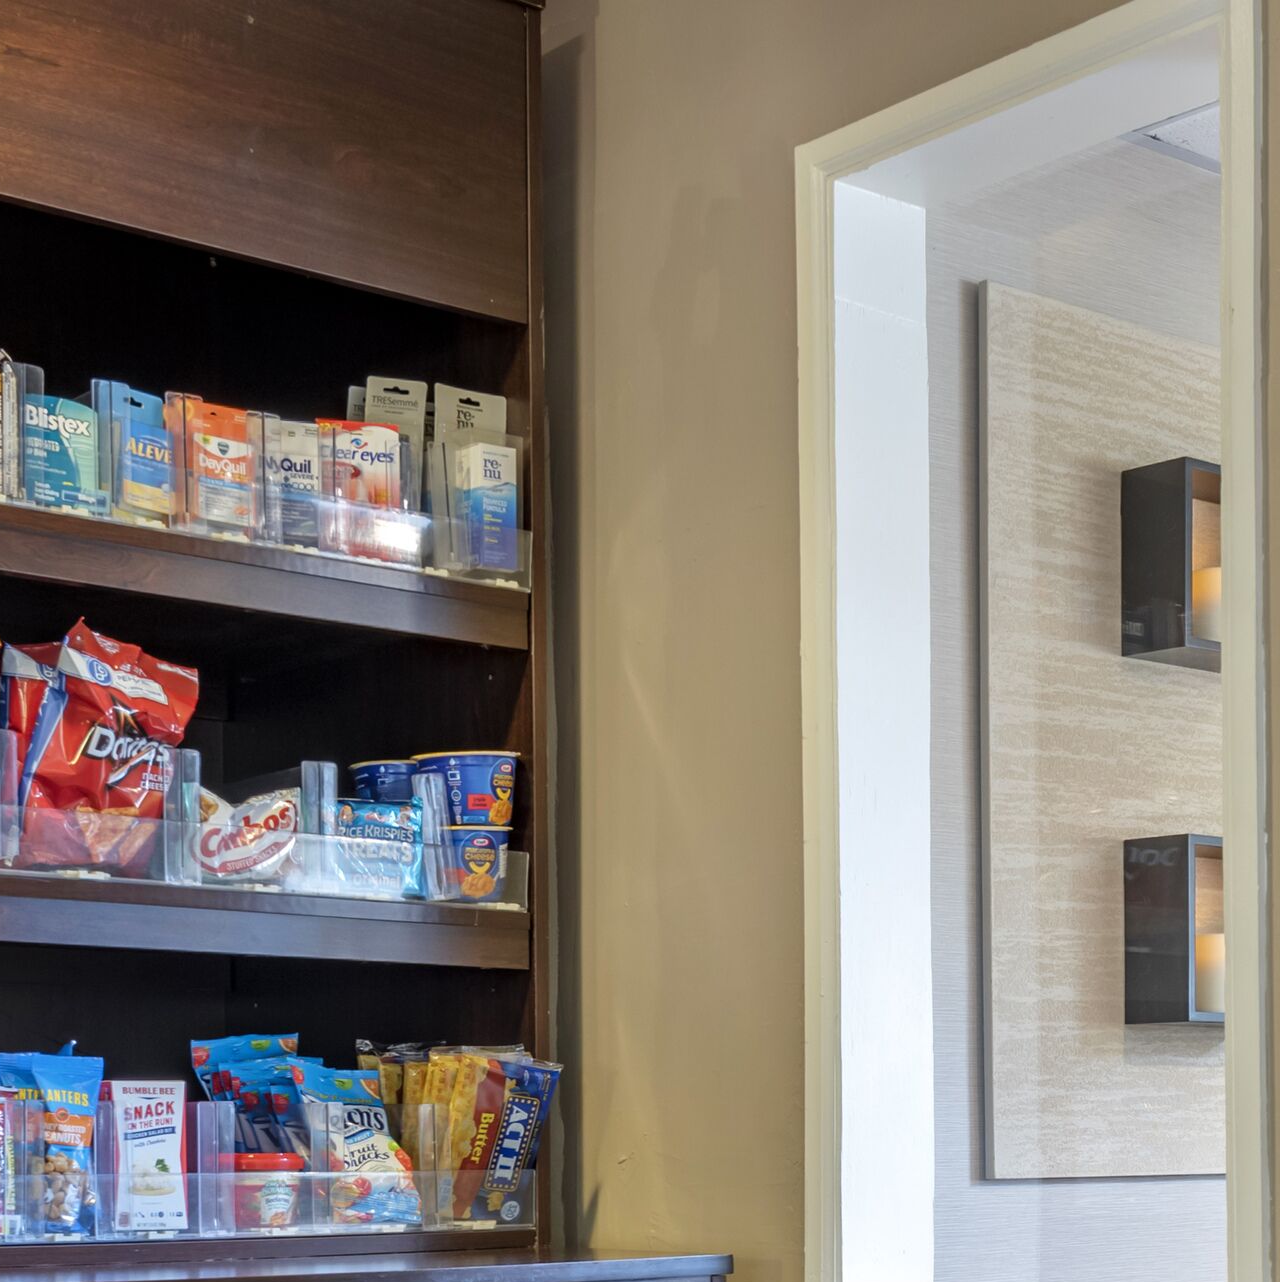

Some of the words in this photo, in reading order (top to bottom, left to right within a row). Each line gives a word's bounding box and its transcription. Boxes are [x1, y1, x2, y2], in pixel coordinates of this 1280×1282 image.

[371, 395, 419, 408] TRESemmé
[24, 403, 91, 439] Blistex
[125, 436, 173, 464] ALEVE
[360, 449, 395, 466] eyes
[198, 453, 247, 476] DayQuil
[258, 455, 312, 475] NyQuil
[483, 468, 502, 480] nu
[290, 472, 315, 481] SEVERE
[86, 724, 174, 763] Doritos
[338, 826, 363, 838] RICE
[364, 825, 414, 842] KRISPIES
[341, 840, 413, 863] TREATS
[40, 1087, 89, 1107] ANTERS
[122, 1086, 158, 1095] BUMBLE
[159, 1087, 176, 1095] BEE
[124, 1100, 176, 1122] SNACK
[139, 1119, 154, 1129] THE
[503, 1104, 529, 1153] ACT
[470, 1112, 496, 1164] Butter
[344, 1143, 379, 1158] ruit
